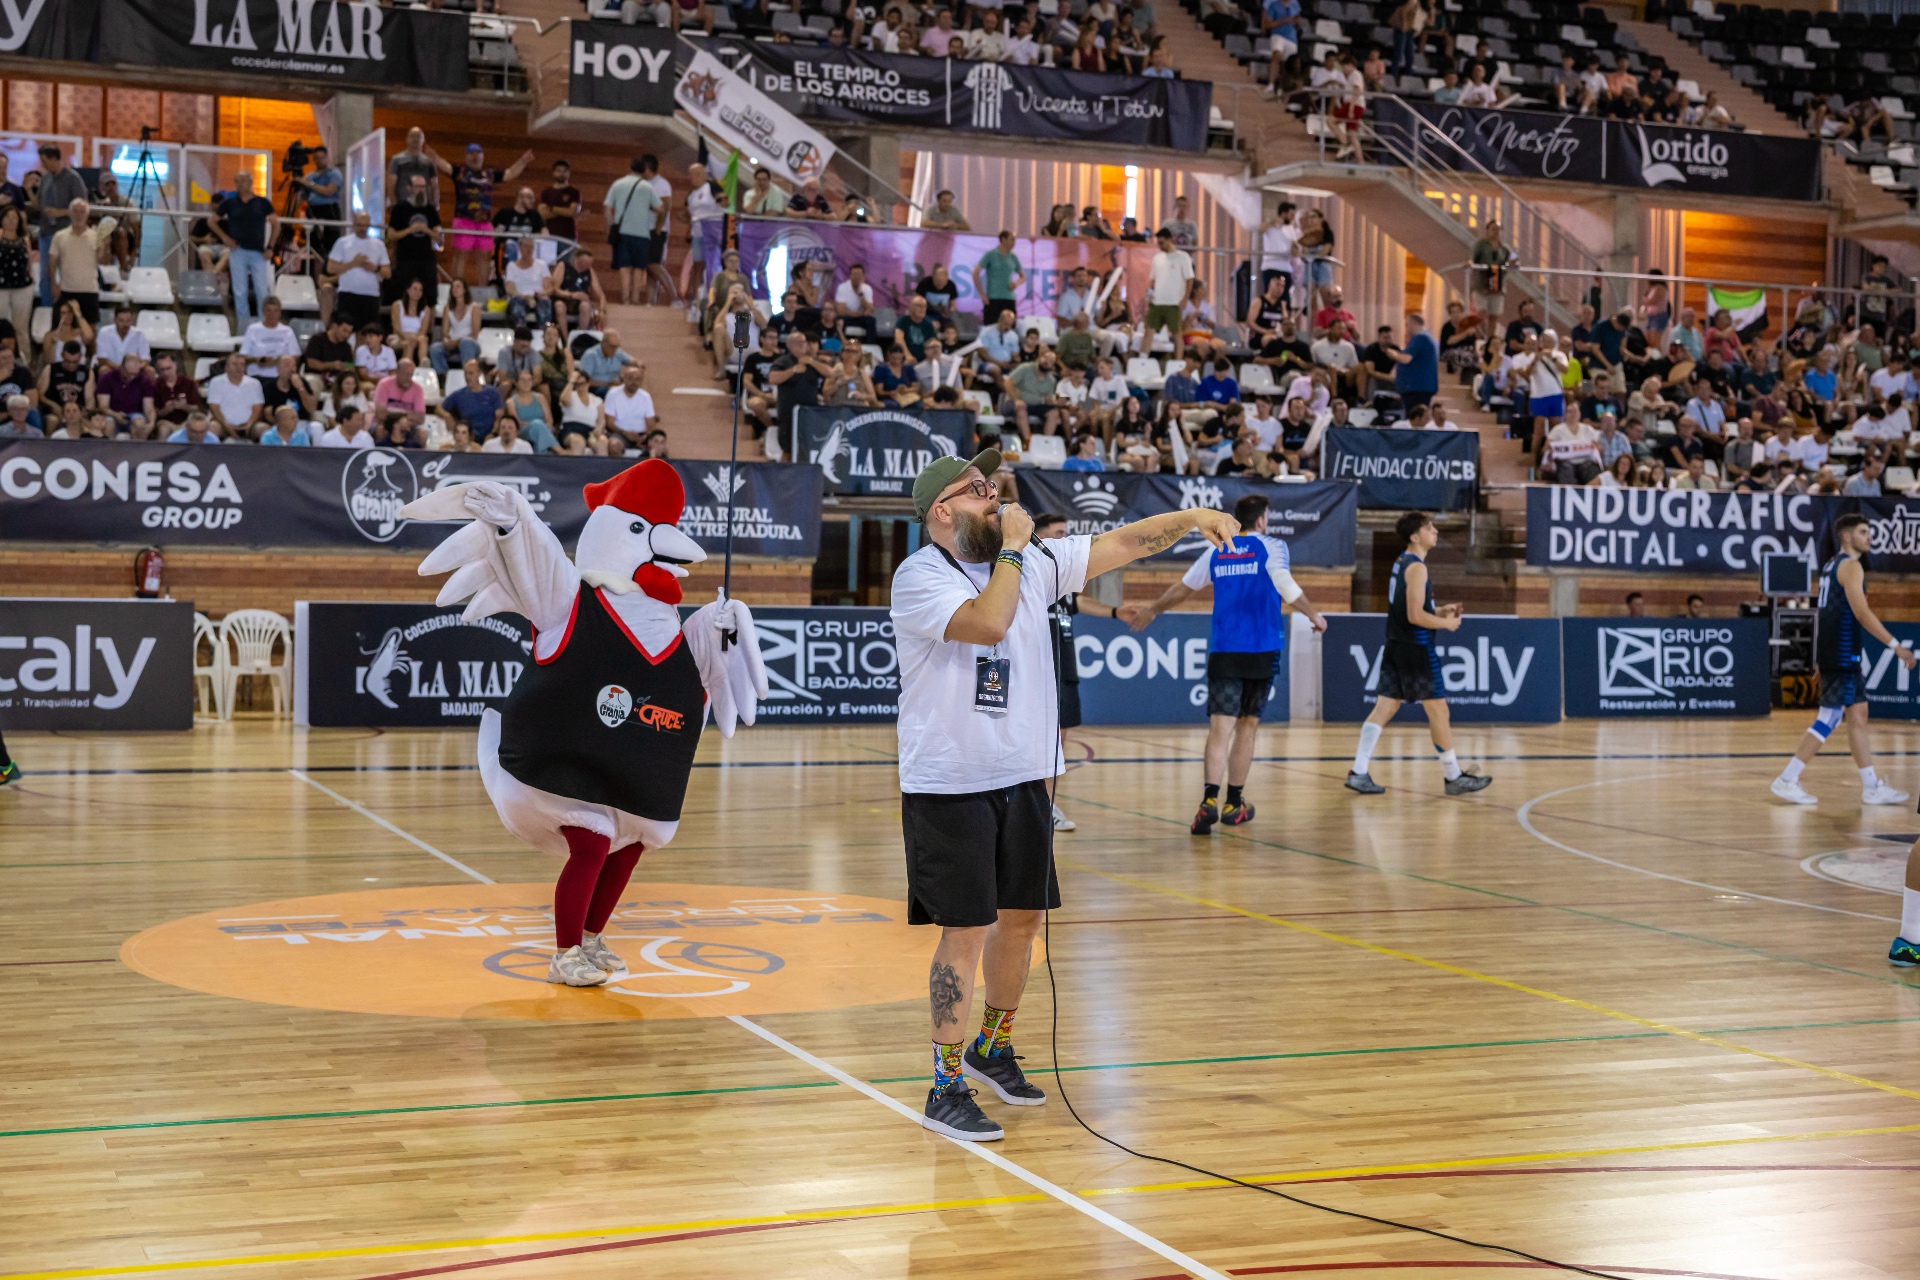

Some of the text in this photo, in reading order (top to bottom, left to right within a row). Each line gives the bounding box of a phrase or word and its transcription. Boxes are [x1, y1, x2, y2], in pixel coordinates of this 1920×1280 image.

[190, 0, 387, 62] LA MAR
[231, 54, 346, 76] cocederolamar.es
[572, 39, 671, 83] HOY
[794, 60, 900, 87] EL TEMPLO
[764, 74, 931, 107] DE LOS ARROCES
[1015, 86, 1089, 115] Vicente
[741, 105, 776, 134] LOS
[1475, 113, 1580, 178] Nuestro
[422, 454, 453, 480] el
[848, 446, 877, 477] LA
[1, 456, 243, 504] CONESA
[869, 479, 903, 492] BADAJOZ
[141, 505, 243, 530] GROUP
[1284, 509, 1320, 522] General
[1550, 486, 1814, 533] INDUGRAFIC
[1549, 526, 1819, 571] DIGITAL COM
[403, 613, 523, 643] COCEDERO D MARISCOS
[805, 620, 895, 638] GRUPO
[1661, 628, 1733, 644] GRUPO
[807, 640, 898, 675] RIO
[1074, 634, 1208, 680] CONE
[1663, 645, 1734, 675] RIO
[408, 660, 450, 697] LA
[807, 676, 898, 690] BADAJOZ
[1664, 676, 1734, 688] BADAJOZ
[23, 697, 90, 709] Tranquilidad
[441, 702, 486, 716] BADAJOZ
[636, 695, 651, 705] el
[826, 704, 836, 717] y
[839, 702, 899, 715] Eventos
[1600, 698, 1736, 711] Restauración y Eventos
[599, 703, 626, 725] Granja
[217, 903, 867, 934] TERCRA FEB
[608, 912, 893, 929] FASE
